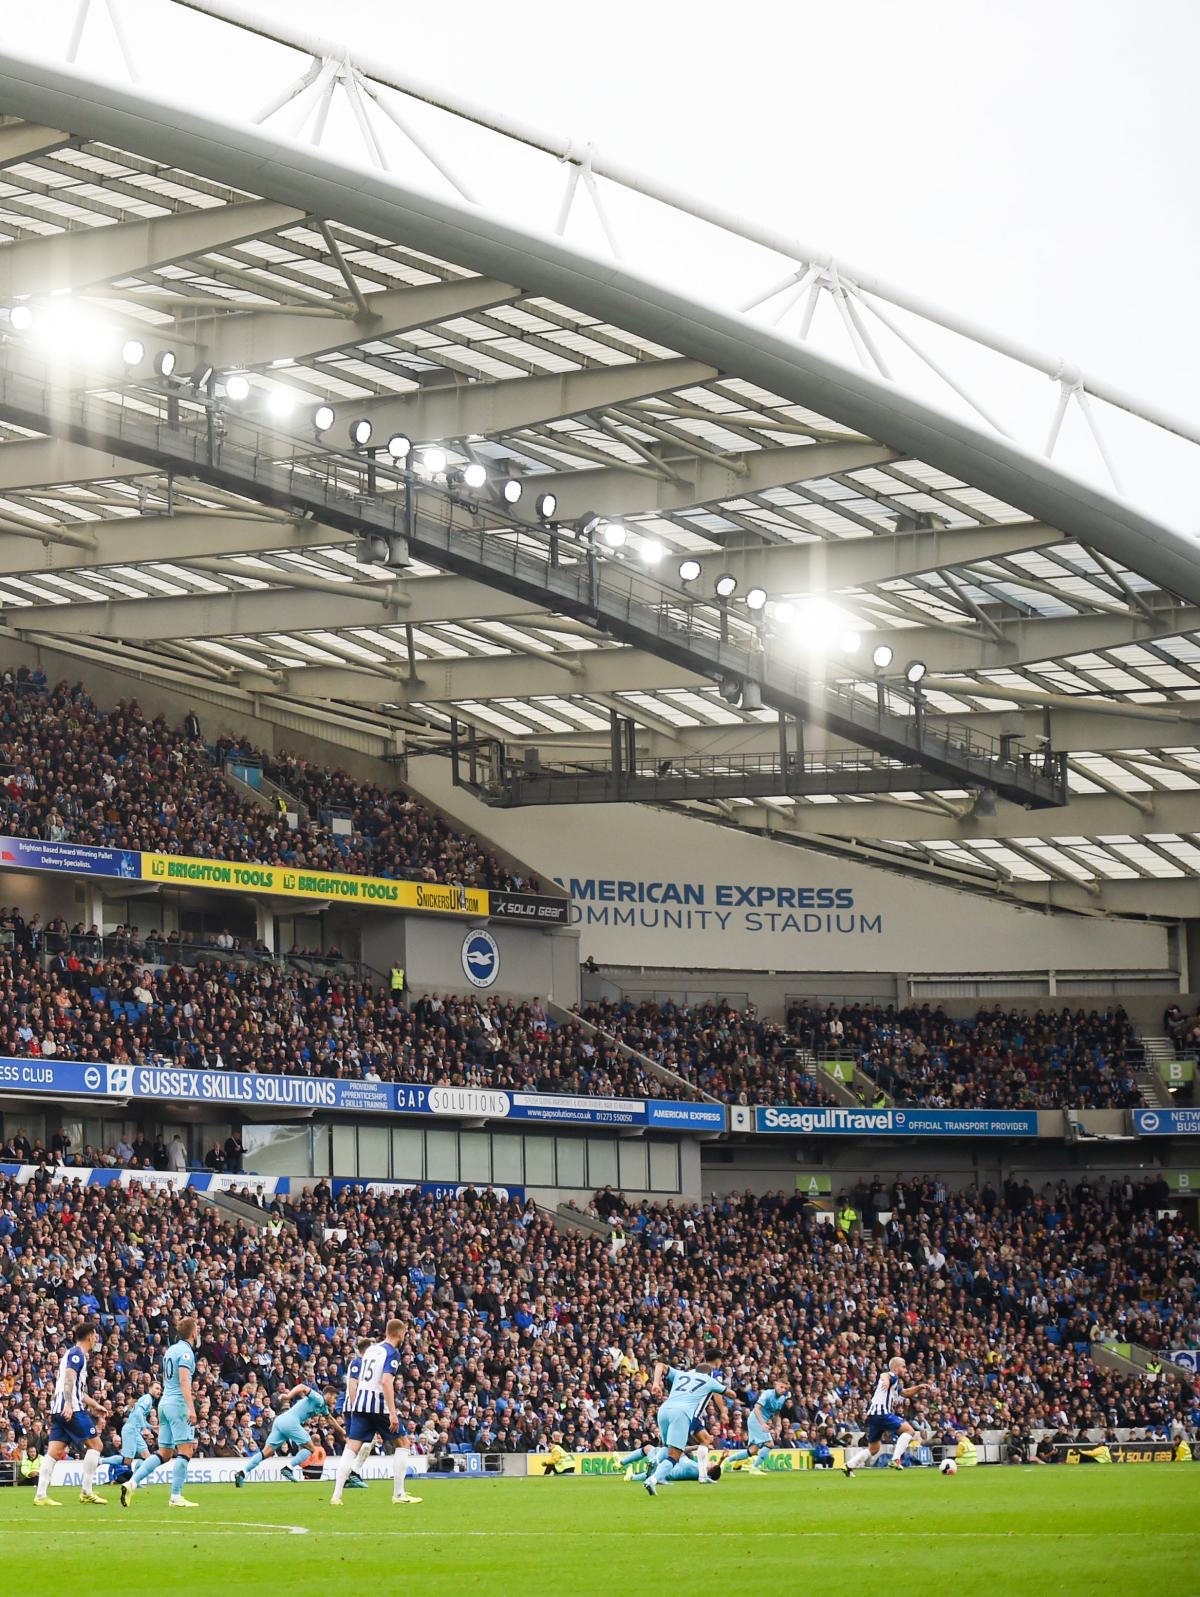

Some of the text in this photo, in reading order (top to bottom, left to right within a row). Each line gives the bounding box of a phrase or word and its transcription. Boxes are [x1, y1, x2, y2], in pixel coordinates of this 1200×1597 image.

[19, 842, 113, 860] Brighton Based Award Winning Pallet
[41, 856, 63, 867] Delivery
[168, 861, 231, 882] BRIGHTON
[234, 871, 273, 887] TOOLS
[298, 876, 358, 895] BRIGHTON
[361, 884, 398, 901] TOOLS
[715, 885, 855, 909] EXPRESS
[507, 902, 536, 914] SOLID
[745, 913, 882, 933] STADIUM
[22, 1066, 53, 1083] CLUB
[834, 1063, 844, 1079] A
[1170, 1063, 1182, 1079] B
[139, 1070, 336, 1105] SUSSEX SKILLS SOLUTIONS
[349, 1083, 378, 1092] PROVIDING
[341, 1090, 387, 1102] APPRENTICESHIPS
[398, 1089, 425, 1108] GAP
[434, 1091, 505, 1113] SOLUTIONS
[345, 1100, 363, 1108] SKILLS
[364, 1101, 388, 1110] TRAINING
[527, 1108, 591, 1121] www.gapsolutions.co.uk
[597, 1112, 612, 1121] 01273
[653, 1109, 721, 1121] AMERICAN EXPRESS
[765, 1108, 1029, 1132] SeagullTravel OFFICIAL TRANSPORT PROVIDER
[808, 1175, 818, 1190] A
[1179, 1174, 1189, 1187] B
[362, 1358, 377, 1382] 15
[675, 1375, 707, 1393] 27
[920, 1449, 928, 1460] H
[470, 1458, 478, 1470] G
[146, 1470, 212, 1484] EXPESS
